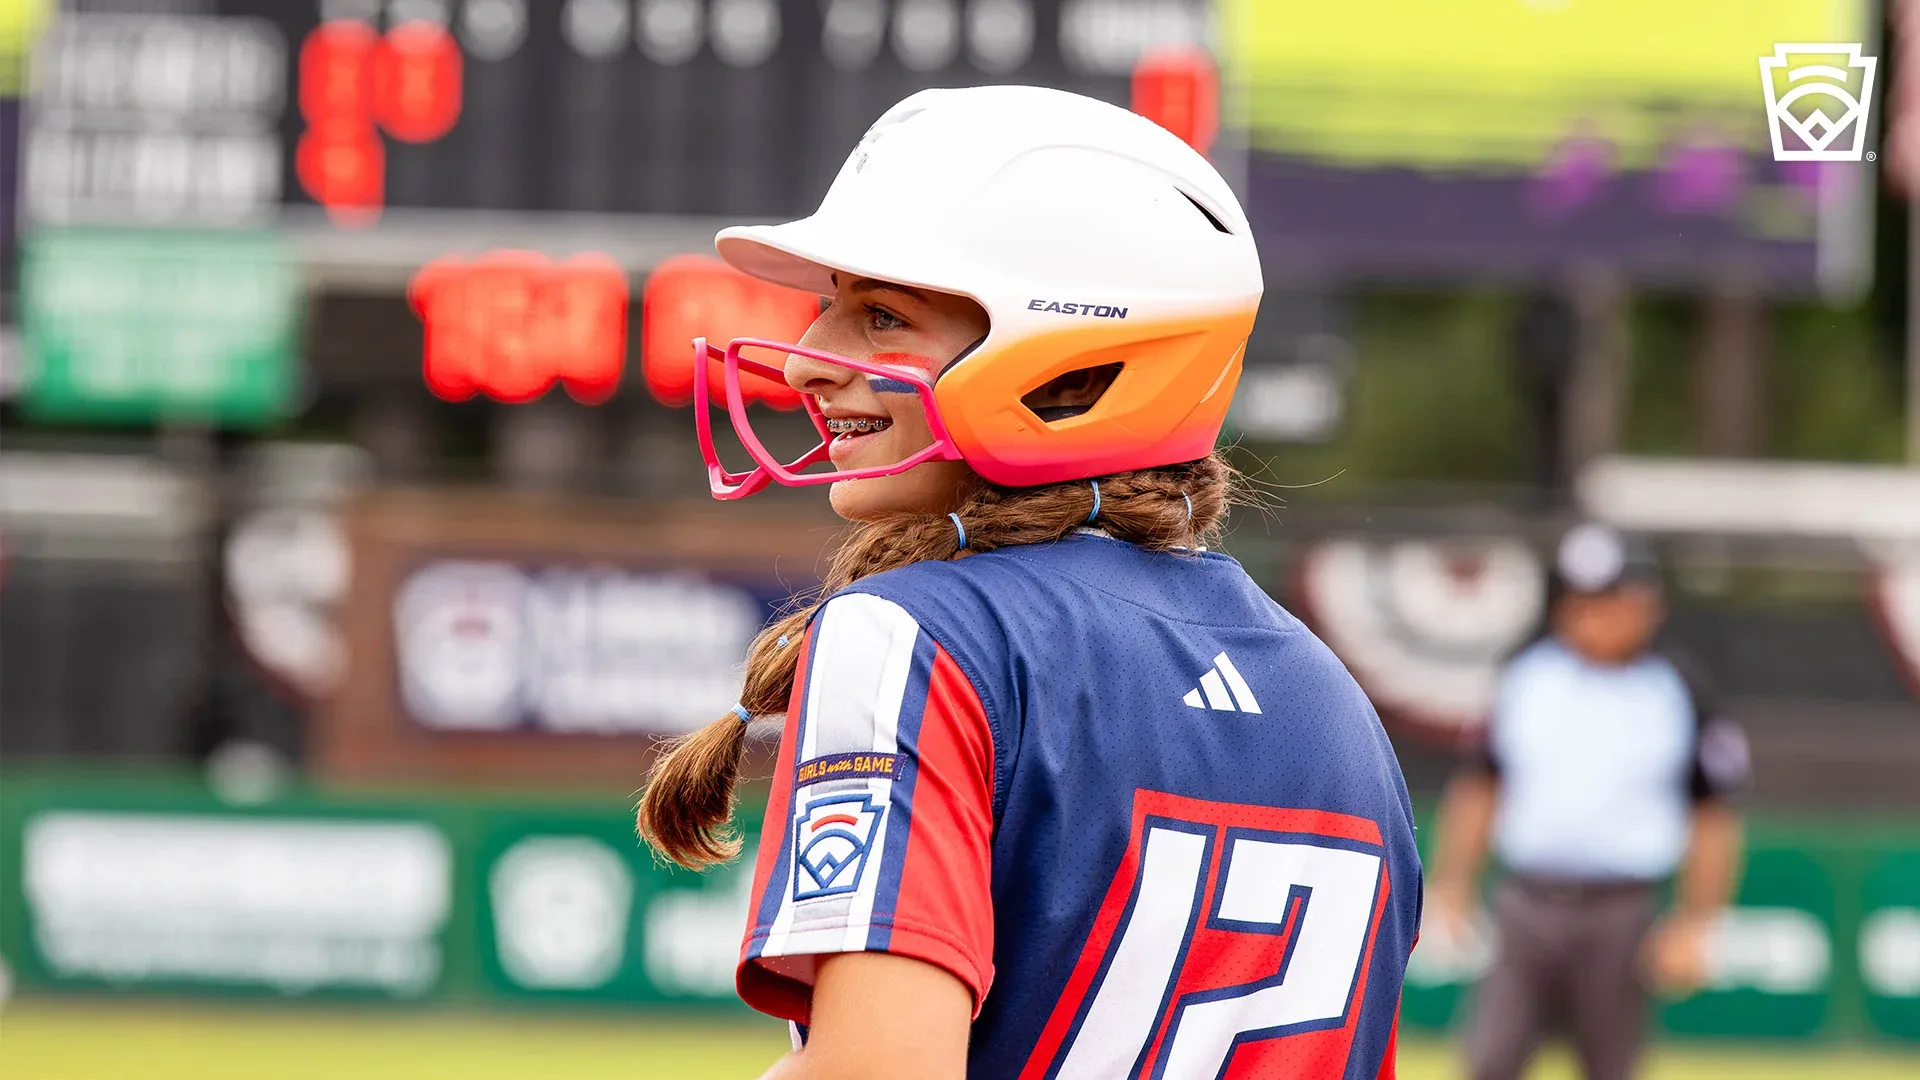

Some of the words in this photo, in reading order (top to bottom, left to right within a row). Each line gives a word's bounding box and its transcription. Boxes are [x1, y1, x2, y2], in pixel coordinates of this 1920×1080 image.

[1027, 299, 1128, 318] EASTON
[798, 760, 827, 782] GIRLS
[827, 759, 854, 774] with
[853, 756, 894, 773] GAME
[1046, 816, 1383, 1080] 12
